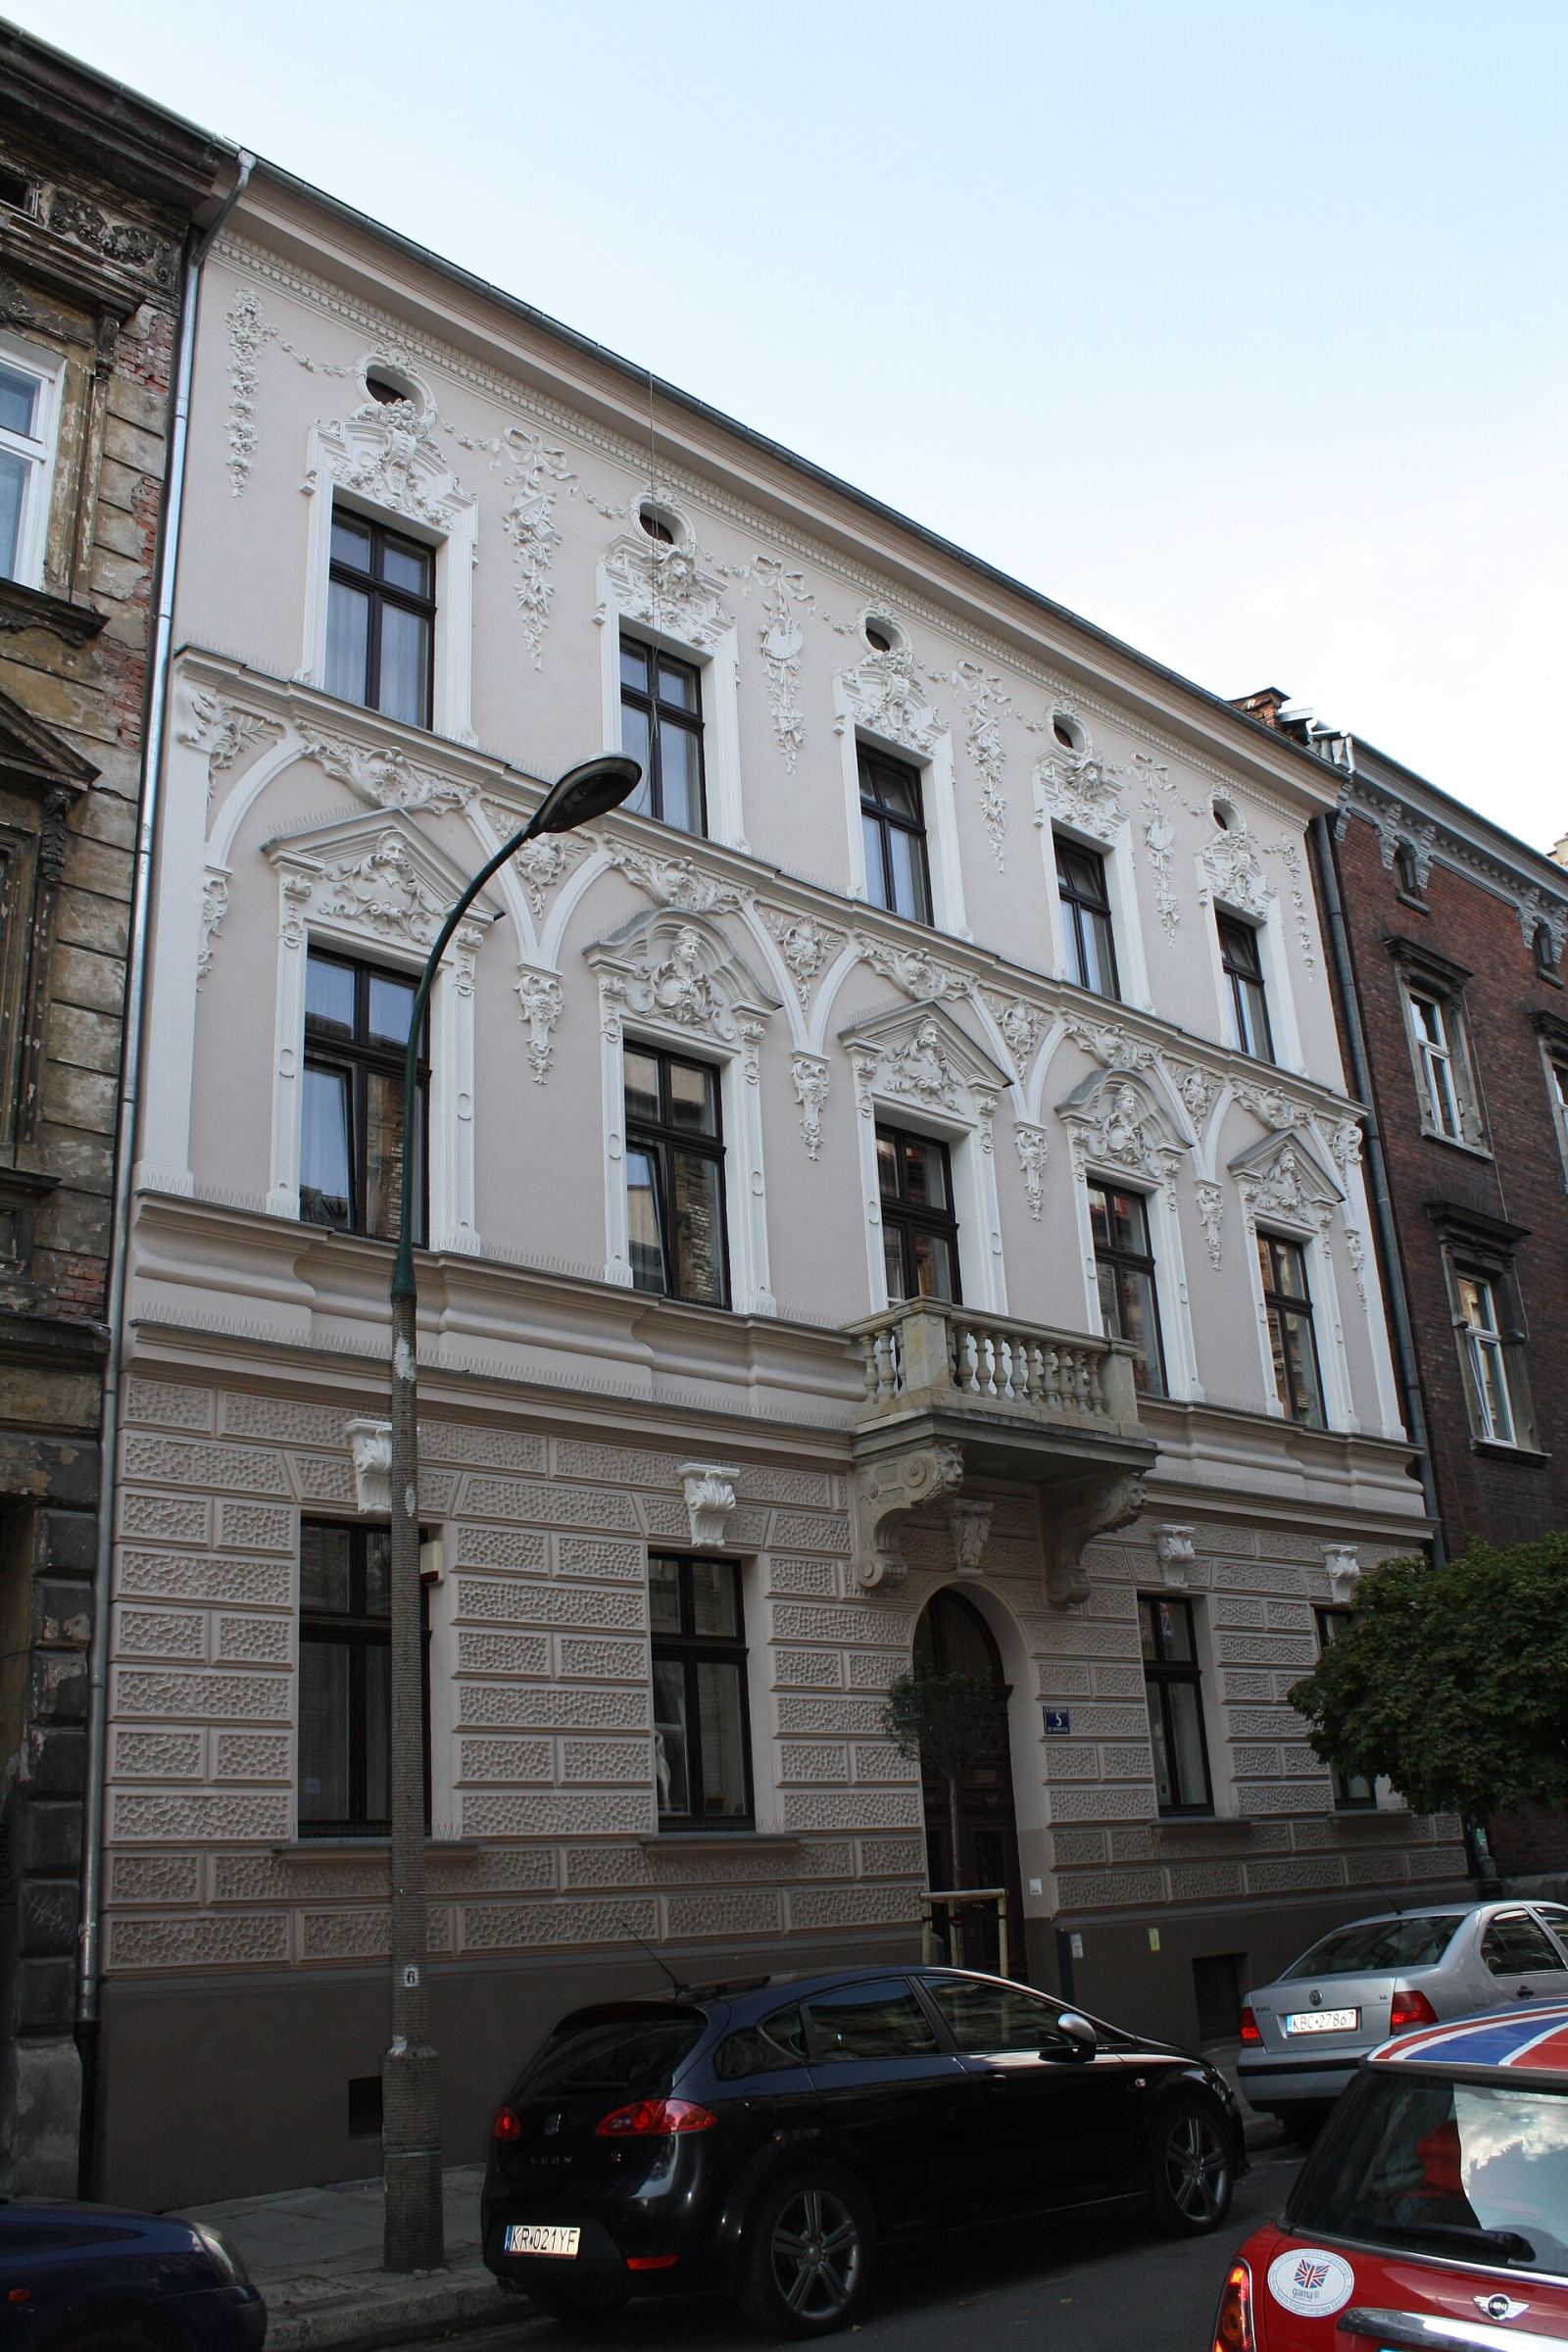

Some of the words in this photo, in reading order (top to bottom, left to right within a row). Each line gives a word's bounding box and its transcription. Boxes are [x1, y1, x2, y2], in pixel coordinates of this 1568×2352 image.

[1055, 1713, 1062, 1727] 5
[1293, 2015, 1313, 2031] KBC
[1318, 2012, 1354, 2029] 27867
[1292, 2287, 1313, 2300] gama
[1489, 2301, 1507, 2312] MINI
